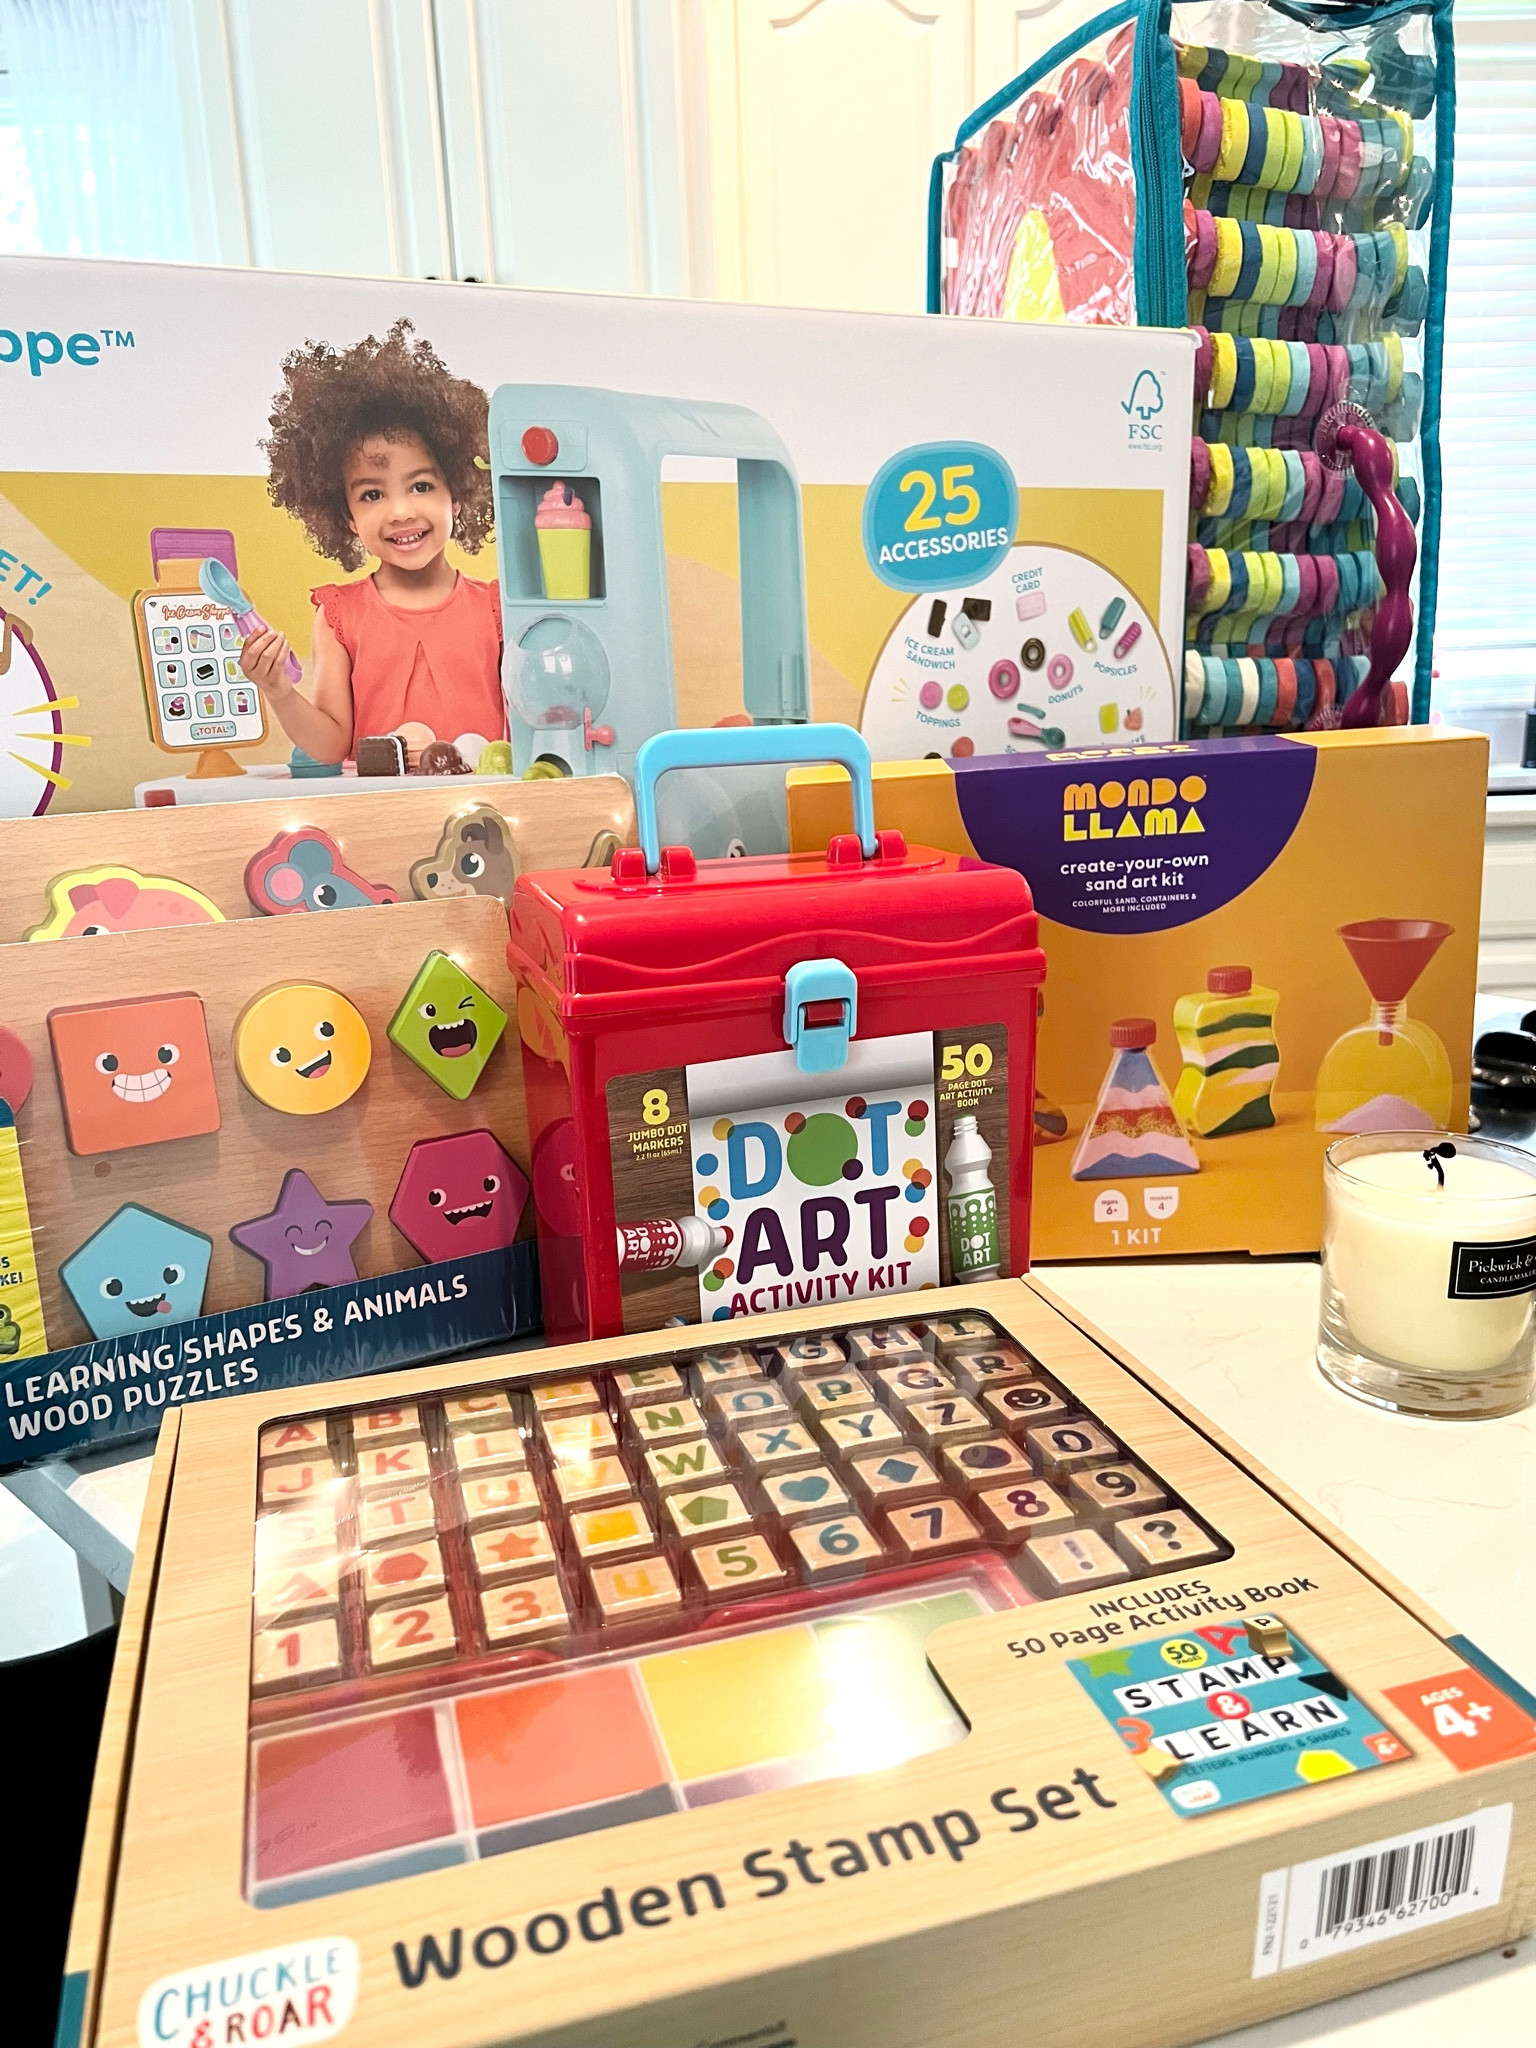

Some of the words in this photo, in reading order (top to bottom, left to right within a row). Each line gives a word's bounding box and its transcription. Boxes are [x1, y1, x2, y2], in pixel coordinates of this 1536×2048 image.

[1128, 424, 1163, 440] FSC
[899, 464, 981, 532] 25
[878, 526, 1009, 565] ACCESSORIES
[1011, 567, 1043, 584] CREDIT
[1016, 580, 1041, 593] CARD
[904, 636, 920, 651] ICE
[920, 644, 955, 656] CREAM
[906, 650, 956, 670] SANDWICH
[1093, 661, 1138, 677] POPSICLES
[1048, 684, 1084, 704] DONUTS
[198, 724, 229, 736] TOTAL
[916, 710, 961, 728] TOPPINGS
[1063, 774, 1207, 812] MONDO
[1063, 806, 1206, 842] LLAMA
[1060, 854, 1209, 875] create-your-own
[1085, 875, 1128, 892] sand
[1131, 874, 1158, 889] art
[1161, 872, 1184, 887] kit
[1072, 899, 1113, 908] COLORFUL
[1140, 893, 1190, 903] CONTAINERS
[1102, 906, 1126, 914] MORE
[1127, 903, 1167, 913] INCLUDED
[941, 1043, 993, 1081] 50
[939, 1091, 956, 1101] ART
[957, 1086, 994, 1099] ACTIVITY
[947, 1080, 970, 1091] PAGE
[970, 1079, 987, 1088] DOT
[642, 1088, 671, 1126] 8
[957, 1097, 980, 1108] BOOK
[627, 1127, 665, 1143] JUMBO
[667, 1123, 688, 1136] DOT
[632, 1135, 684, 1154] MARKERS
[726, 1100, 903, 1201] DOT
[1106, 1206, 1118, 1216] 6+
[1158, 1202, 1166, 1211] 4
[735, 1184, 901, 1285] ART
[1111, 1229, 1119, 1246] 1
[1127, 1227, 1162, 1245] KIT
[962, 1247, 991, 1268] ART
[1468, 1254, 1523, 1273] Pickwick
[1524, 1253, 1534, 1267] &
[729, 1270, 859, 1319] ACTIVITY
[867, 1260, 912, 1292] KIT
[4, 1343, 175, 1408] LEARNING
[183, 1313, 304, 1365] SHAPES
[312, 1307, 335, 1333] &
[344, 1273, 469, 1326] ANIMALS
[8, 1394, 114, 1441] WOOD
[123, 1357, 260, 1413] PUZZLES
[274, 1423, 317, 1448] A
[367, 1410, 404, 1430] B
[277, 1467, 313, 1493] J
[375, 1449, 413, 1475] K
[644, 1406, 685, 1431] N
[816, 1379, 853, 1402] P
[374, 1496, 416, 1525] T
[477, 1479, 521, 1508] U
[656, 1444, 707, 1476] W
[756, 1428, 802, 1454] X
[838, 1414, 875, 1438] Y
[926, 1402, 972, 1425] Z
[1142, 1519, 1183, 1551] ?
[277, 1632, 301, 1668] 1
[392, 1610, 436, 1648] 2
[501, 1590, 542, 1626] 3
[716, 1545, 758, 1577] 5
[818, 1524, 860, 1555] 6
[910, 1507, 943, 1540] 7
[1006, 1489, 1051, 1518] 8
[1095, 1471, 1137, 1498] 9
[1088, 1579, 1212, 1618] INCLUDES
[1007, 1636, 1046, 1659] 50
[1049, 1621, 1124, 1645] Page
[1128, 1590, 1248, 1631] Activity
[1243, 1576, 1320, 1603] Book
[1165, 1642, 1199, 1660] 50
[1124, 1655, 1287, 1709] STAMP
[1215, 1693, 1246, 1715] &
[1420, 1686, 1465, 1707] AGES
[1164, 1699, 1339, 1760] LEARN
[1433, 1702, 1493, 1738] 4+
[393, 1869, 728, 1990] Wooden
[742, 1806, 982, 1899] Stamp
[989, 1766, 1119, 1834] Set
[1332, 1916, 1388, 1940] 79346
[1395, 1891, 1451, 1920] 62700
[153, 1946, 343, 2042] CHUCKLE
[225, 1984, 334, 2044] ROAR
